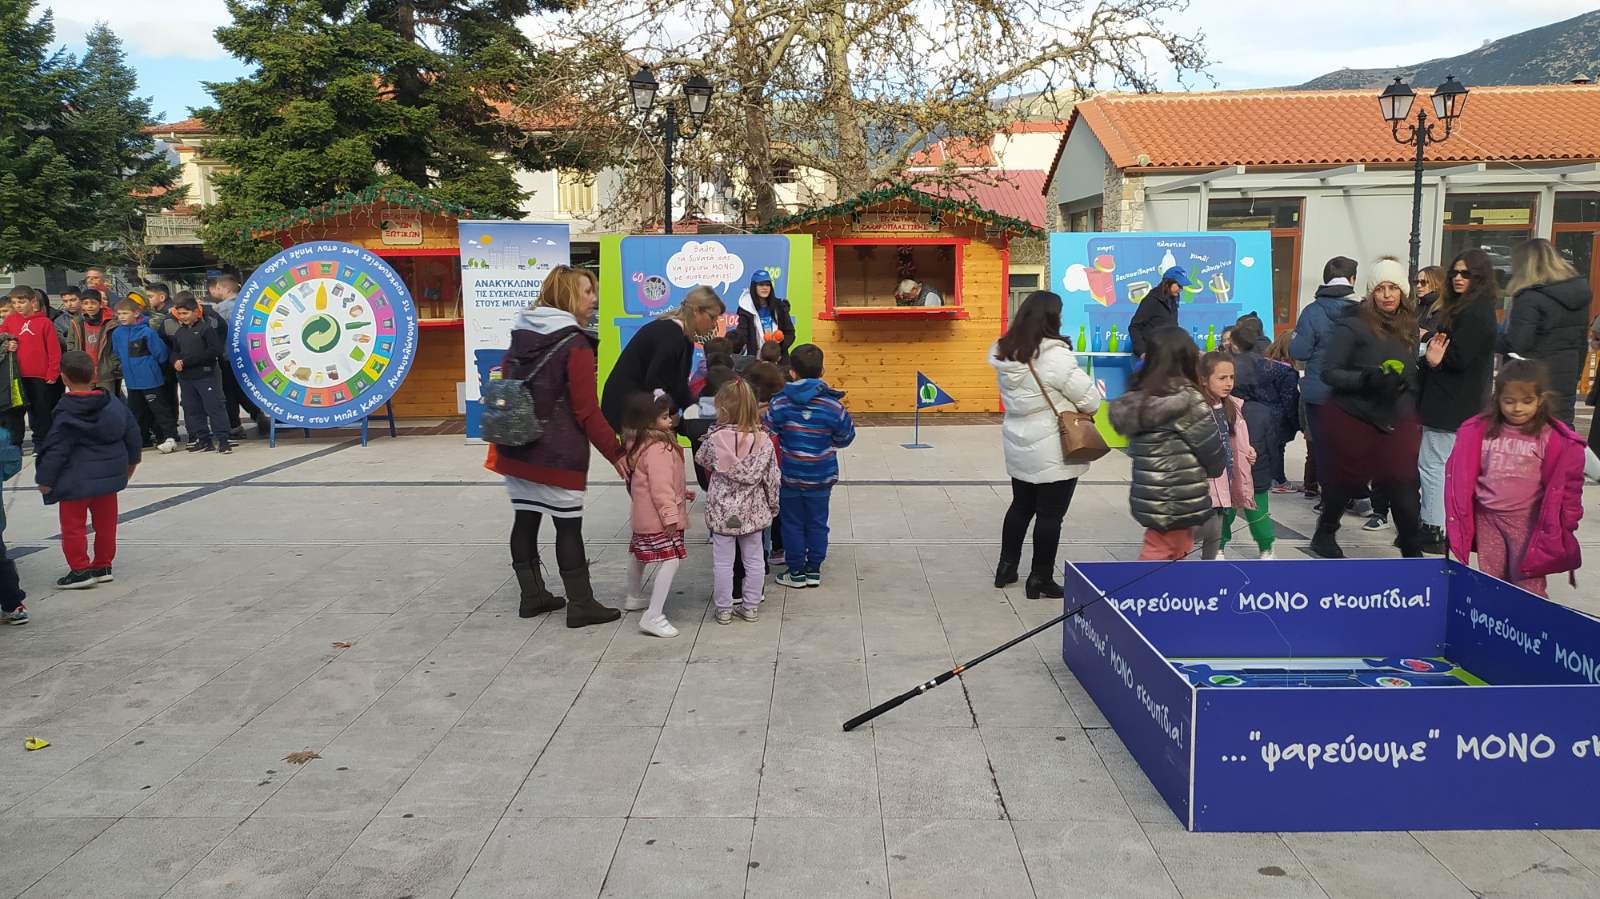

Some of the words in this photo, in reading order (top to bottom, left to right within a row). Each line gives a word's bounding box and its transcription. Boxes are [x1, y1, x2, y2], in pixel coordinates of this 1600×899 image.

[475, 290, 488, 298] ΤΙΣ
[489, 290, 540, 298] ΣΥΣΚΕΥΑΣΙΕΣ
[475, 299, 501, 307] ΣΤΟΥΣ
[502, 299, 526, 307] ΜΠΛΕ
[1239, 591, 1309, 612] ΜΟΝΟ
[1319, 586, 1431, 610] σκουπίδια!
[1110, 645, 1134, 689] ΜΟΝΟ
[1136, 685, 1183, 749] σκουπίδια!
[1457, 732, 1556, 763] ΜΟΝΟ
